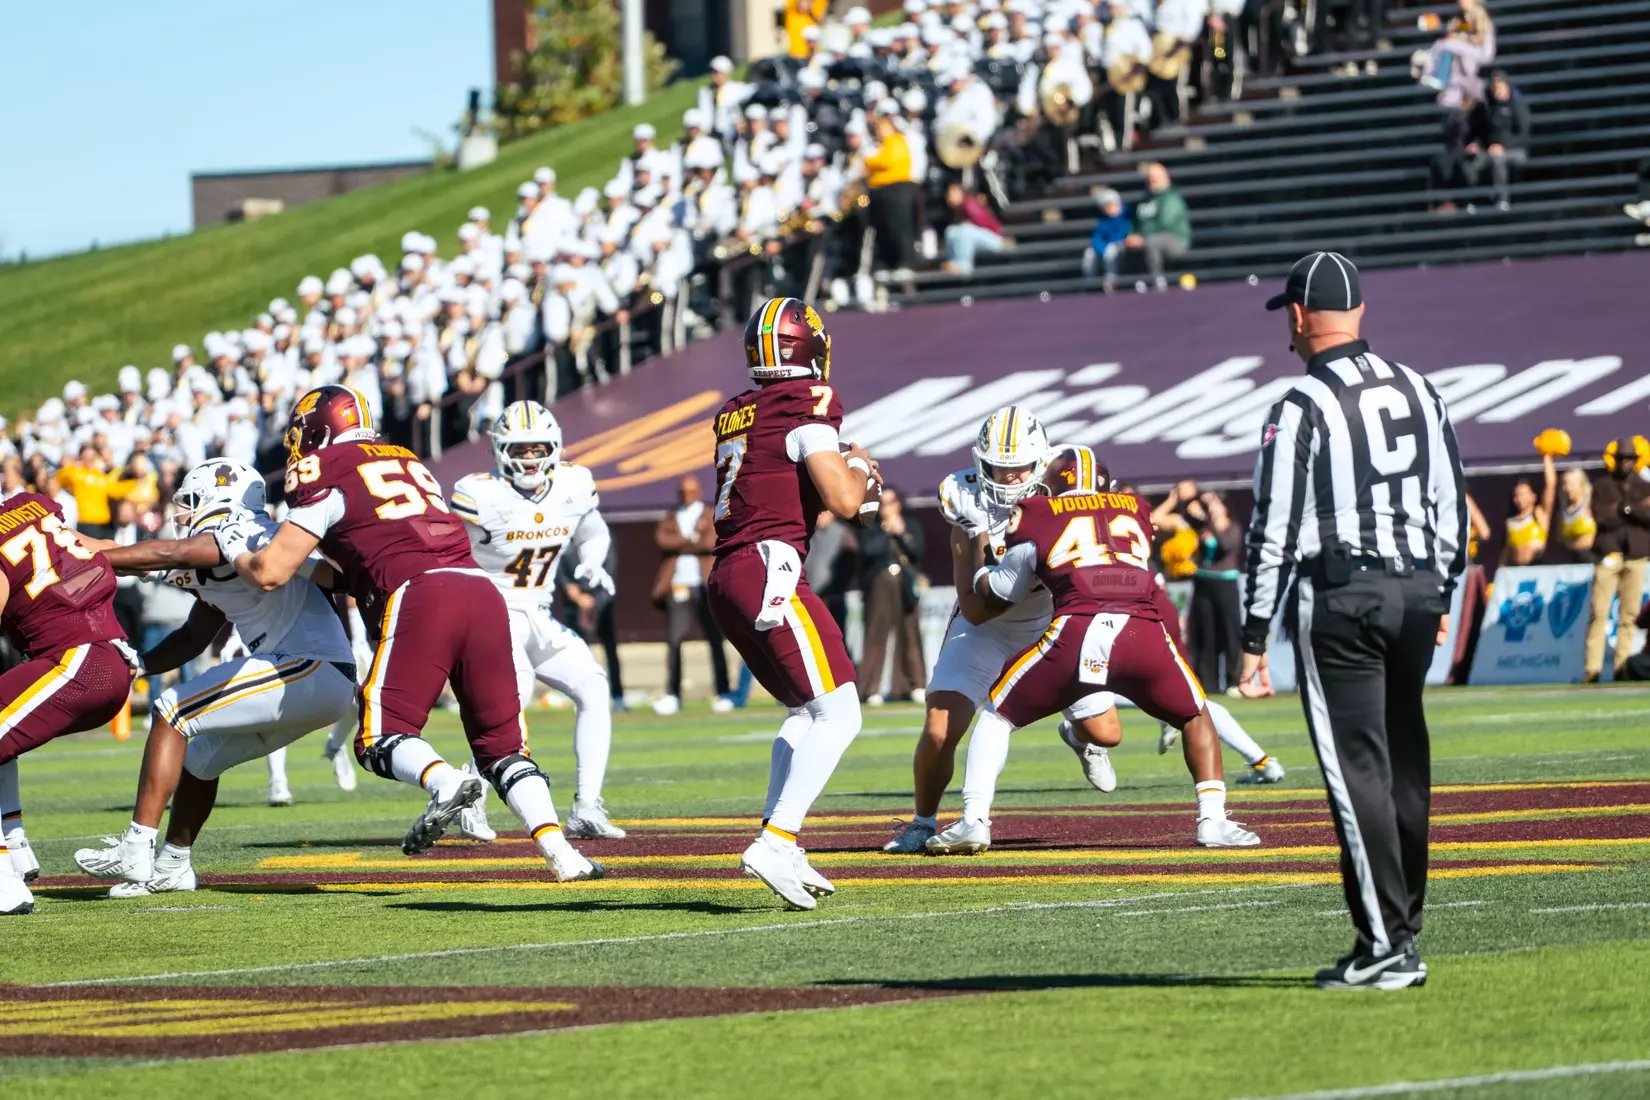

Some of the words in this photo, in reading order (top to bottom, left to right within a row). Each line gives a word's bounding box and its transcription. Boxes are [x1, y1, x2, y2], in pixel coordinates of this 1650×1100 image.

[753, 368, 793, 378] RESPECT
[717, 403, 757, 437] FLORES
[809, 385, 833, 417] 7
[1358, 384, 1418, 477] C
[356, 459, 450, 520] 59
[714, 434, 748, 523] 7
[1048, 492, 1139, 516] WOODFORD
[506, 526, 569, 542] BRONCOS
[1046, 514, 1150, 571] 43
[0, 512, 98, 600] 78
[504, 543, 562, 589] 47
[1093, 574, 1137, 587] DOUGLAS
